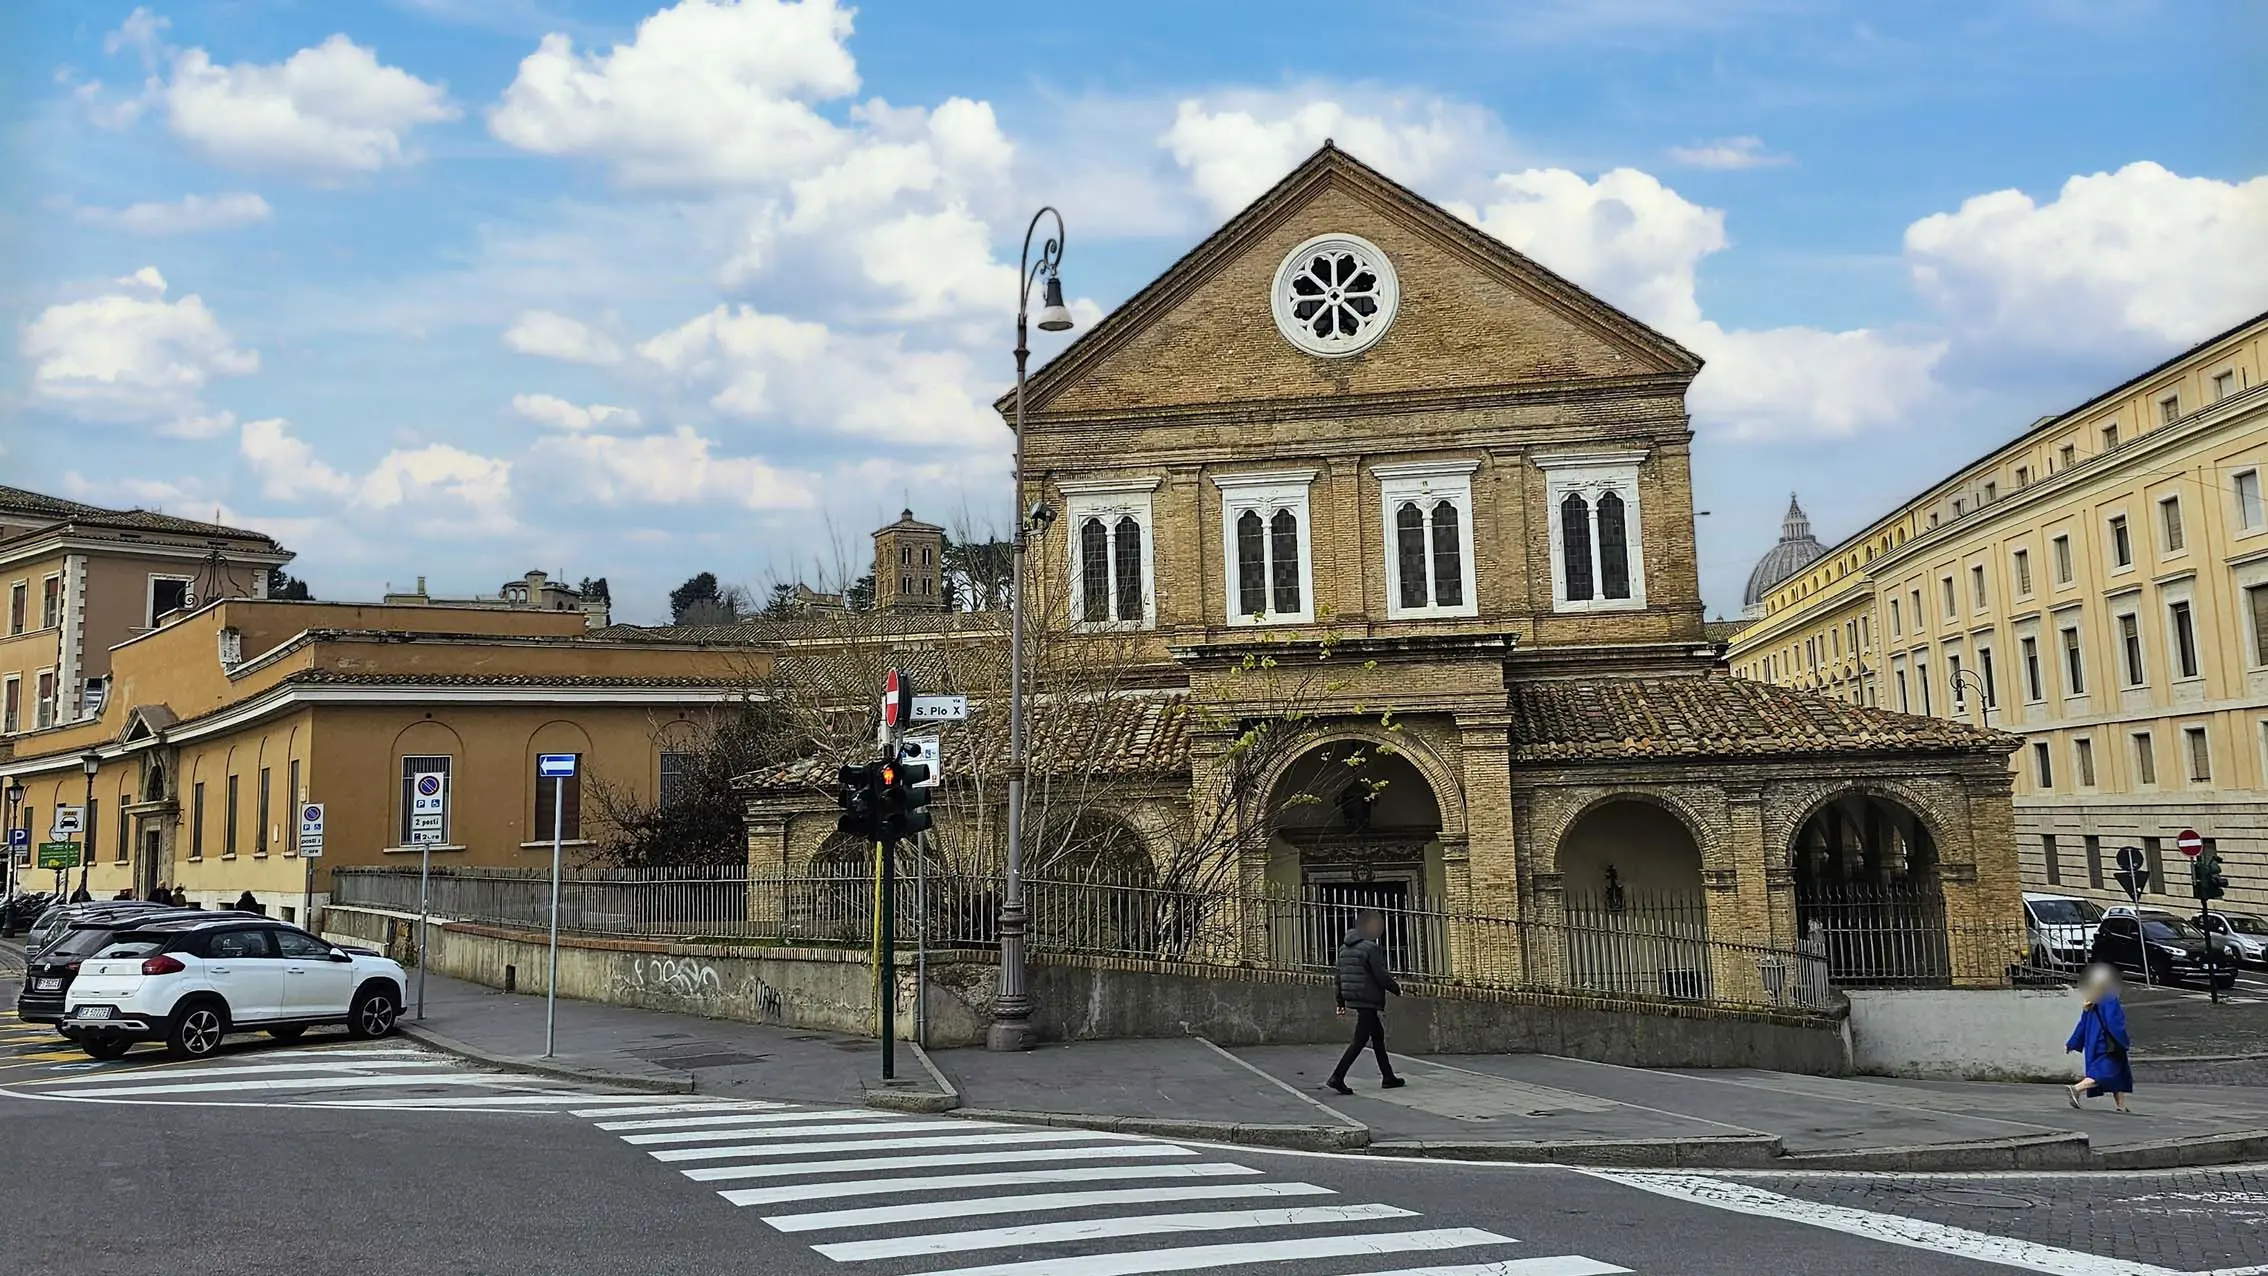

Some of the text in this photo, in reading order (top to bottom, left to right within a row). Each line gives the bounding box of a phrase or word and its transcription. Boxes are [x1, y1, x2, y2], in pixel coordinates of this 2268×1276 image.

[916, 706, 960, 716] S. Pio X
[415, 817, 439, 827] 2 posti
[14, 830, 26, 844] P
